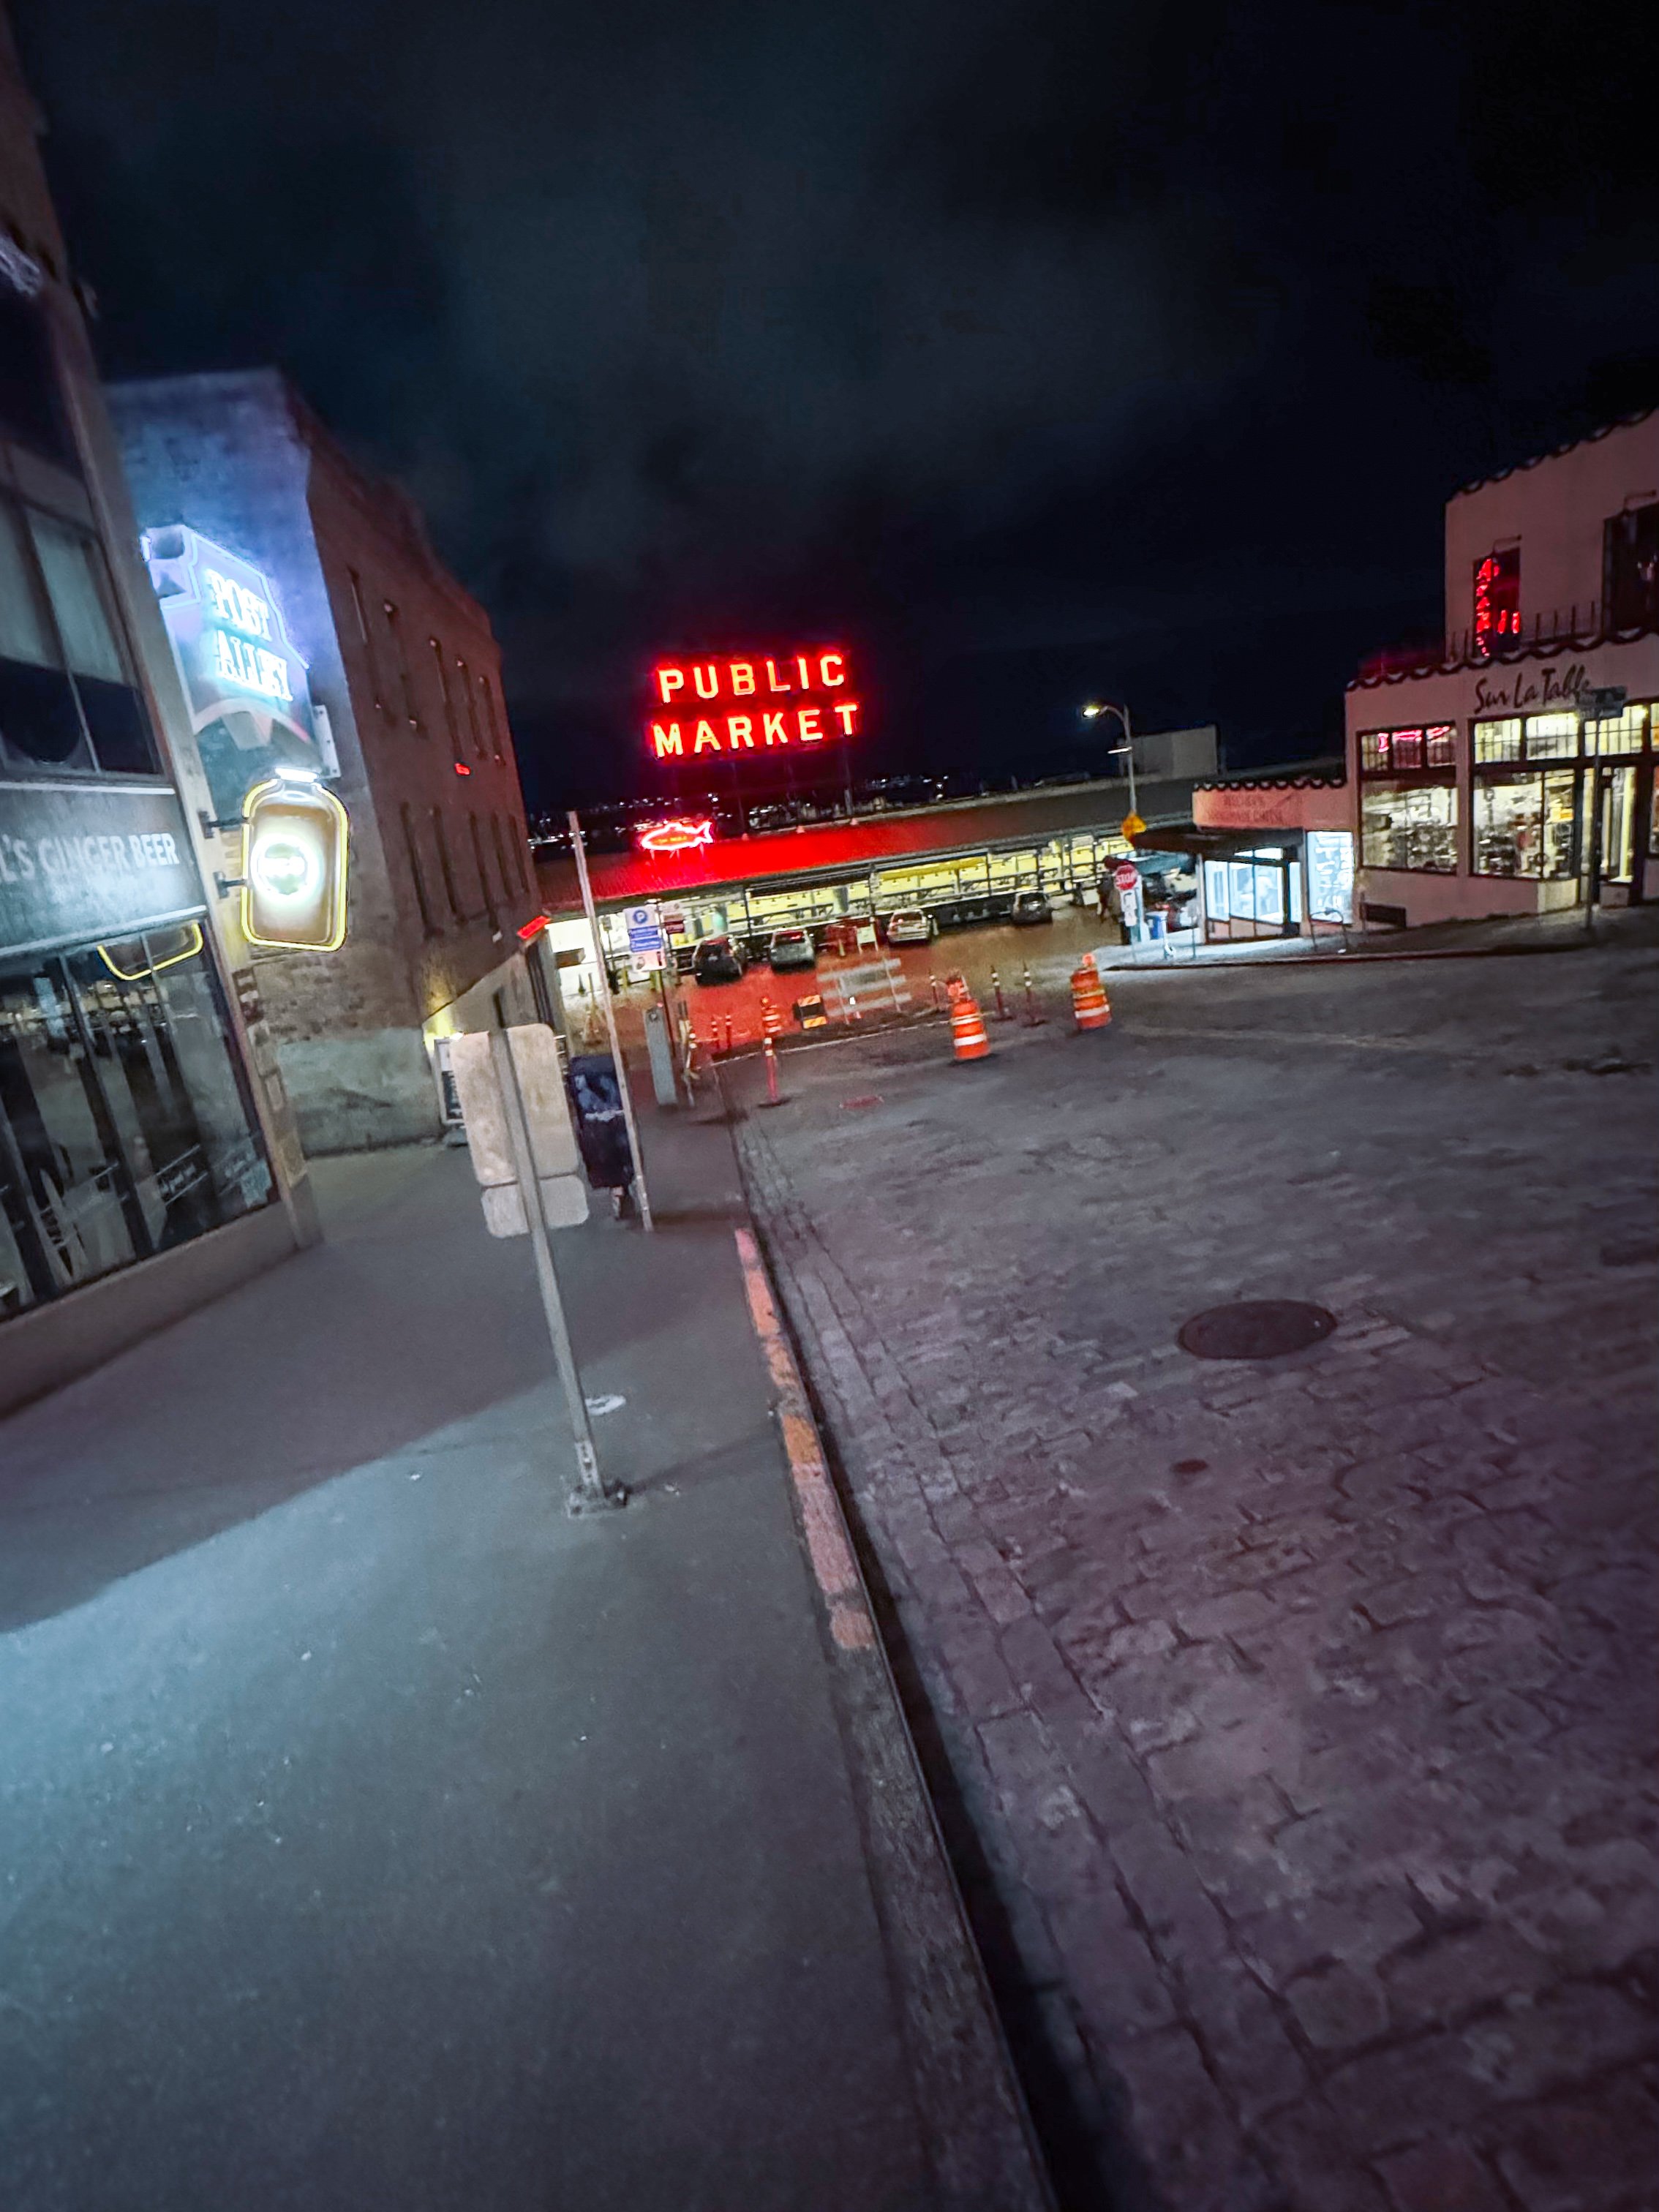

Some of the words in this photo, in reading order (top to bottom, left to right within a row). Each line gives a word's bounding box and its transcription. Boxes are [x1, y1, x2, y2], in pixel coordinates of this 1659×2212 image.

[206, 568, 272, 642] POST
[217, 630, 293, 701] ALLEY
[658, 655, 845, 703] PUBLIC
[1475, 677, 1508, 714] Sur
[1513, 671, 1538, 708] La
[1541, 665, 1592, 705] Table
[653, 704, 857, 758] MARKET
[38, 835, 131, 877] GINGER
[129, 832, 180, 868] BEER
[1116, 870, 1137, 884] STOP
